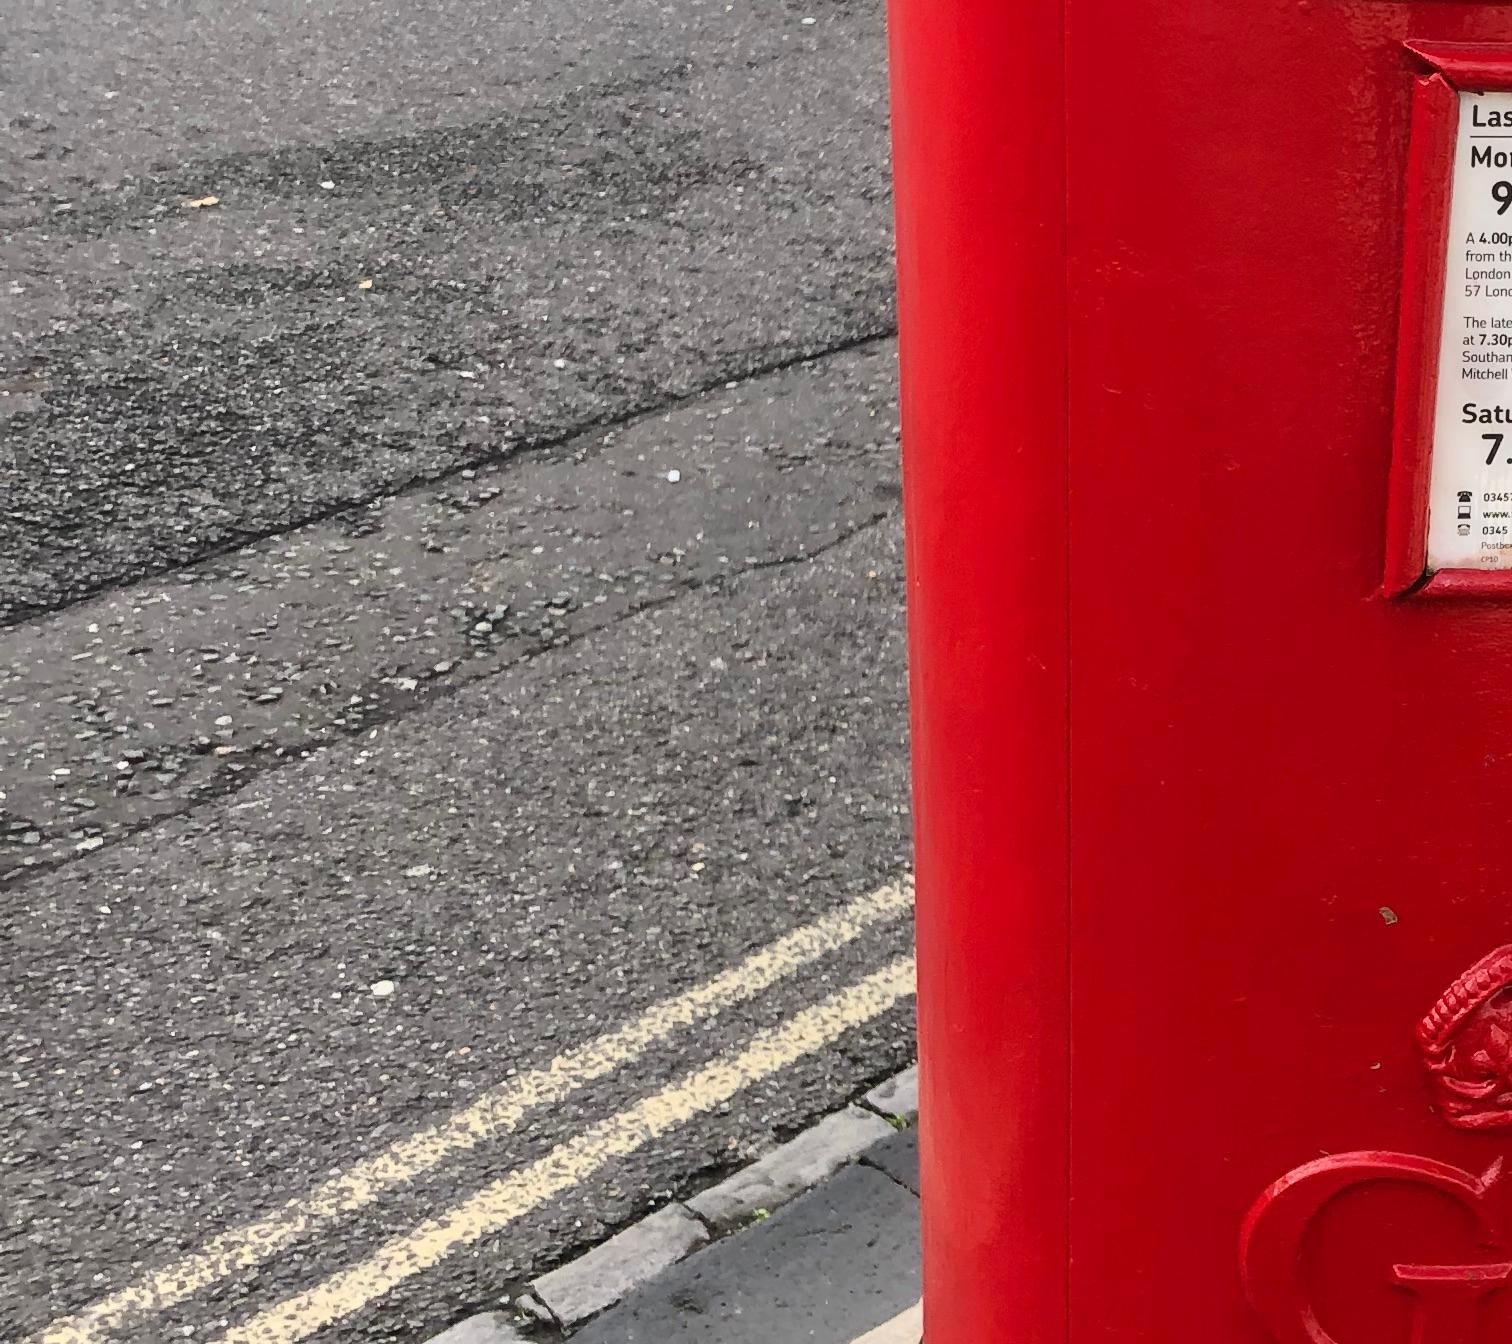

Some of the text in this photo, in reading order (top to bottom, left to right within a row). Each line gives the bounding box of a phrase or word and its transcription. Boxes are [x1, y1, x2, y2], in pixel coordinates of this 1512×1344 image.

[1466, 232, 1475, 244] A
[1465, 250, 1495, 262] from
[1465, 268, 1511, 280] London
[1465, 285, 1480, 297] 57
[1464, 316, 1487, 328] The
[1463, 336, 1474, 345] at
[1462, 367, 1507, 380] Mitchell
[1482, 526, 1508, 535] 0345
[1481, 542, 1512, 550] Postbox
